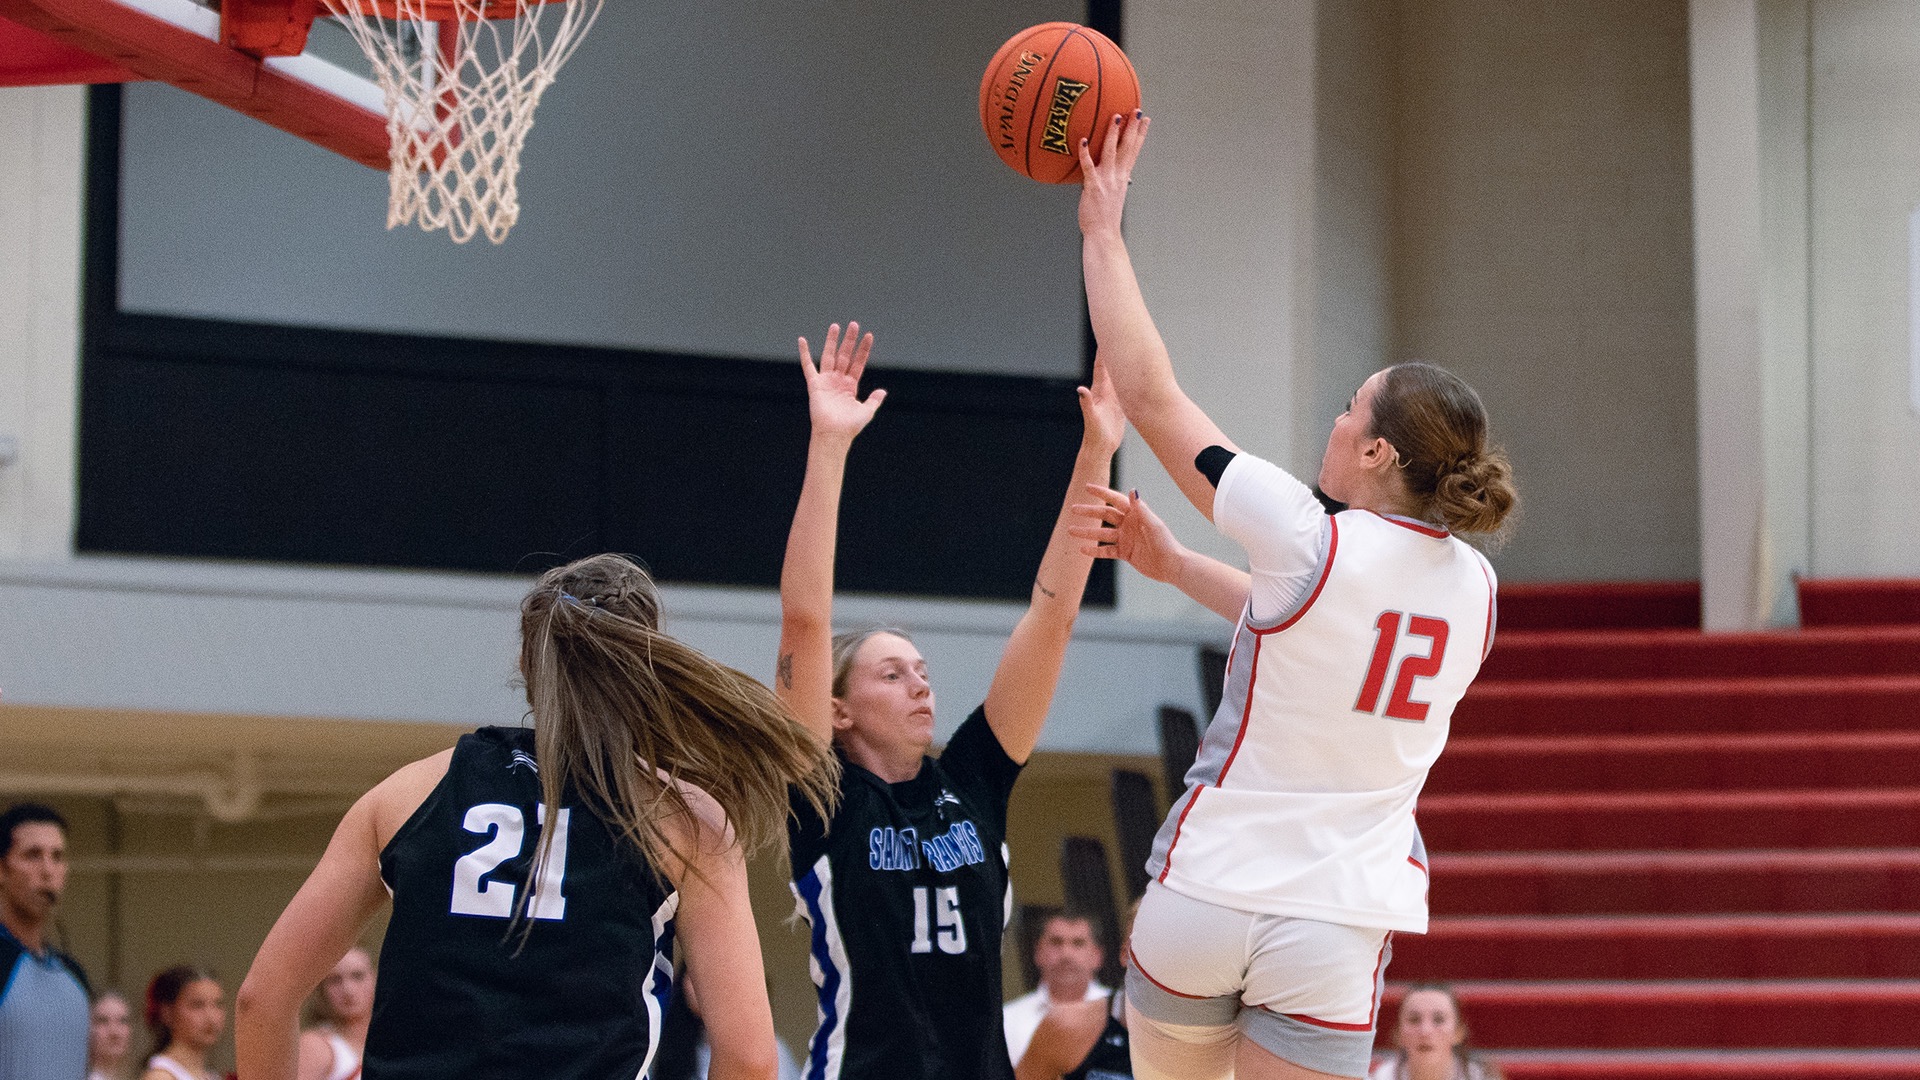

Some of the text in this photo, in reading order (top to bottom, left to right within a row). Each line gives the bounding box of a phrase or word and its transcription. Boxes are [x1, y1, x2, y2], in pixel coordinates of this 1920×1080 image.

[1000, 49, 1045, 151] SPALDING
[1040, 76, 1091, 157] NAIA
[1352, 609, 1451, 724] 12
[449, 801, 571, 921] 21
[910, 886, 967, 955] 15
